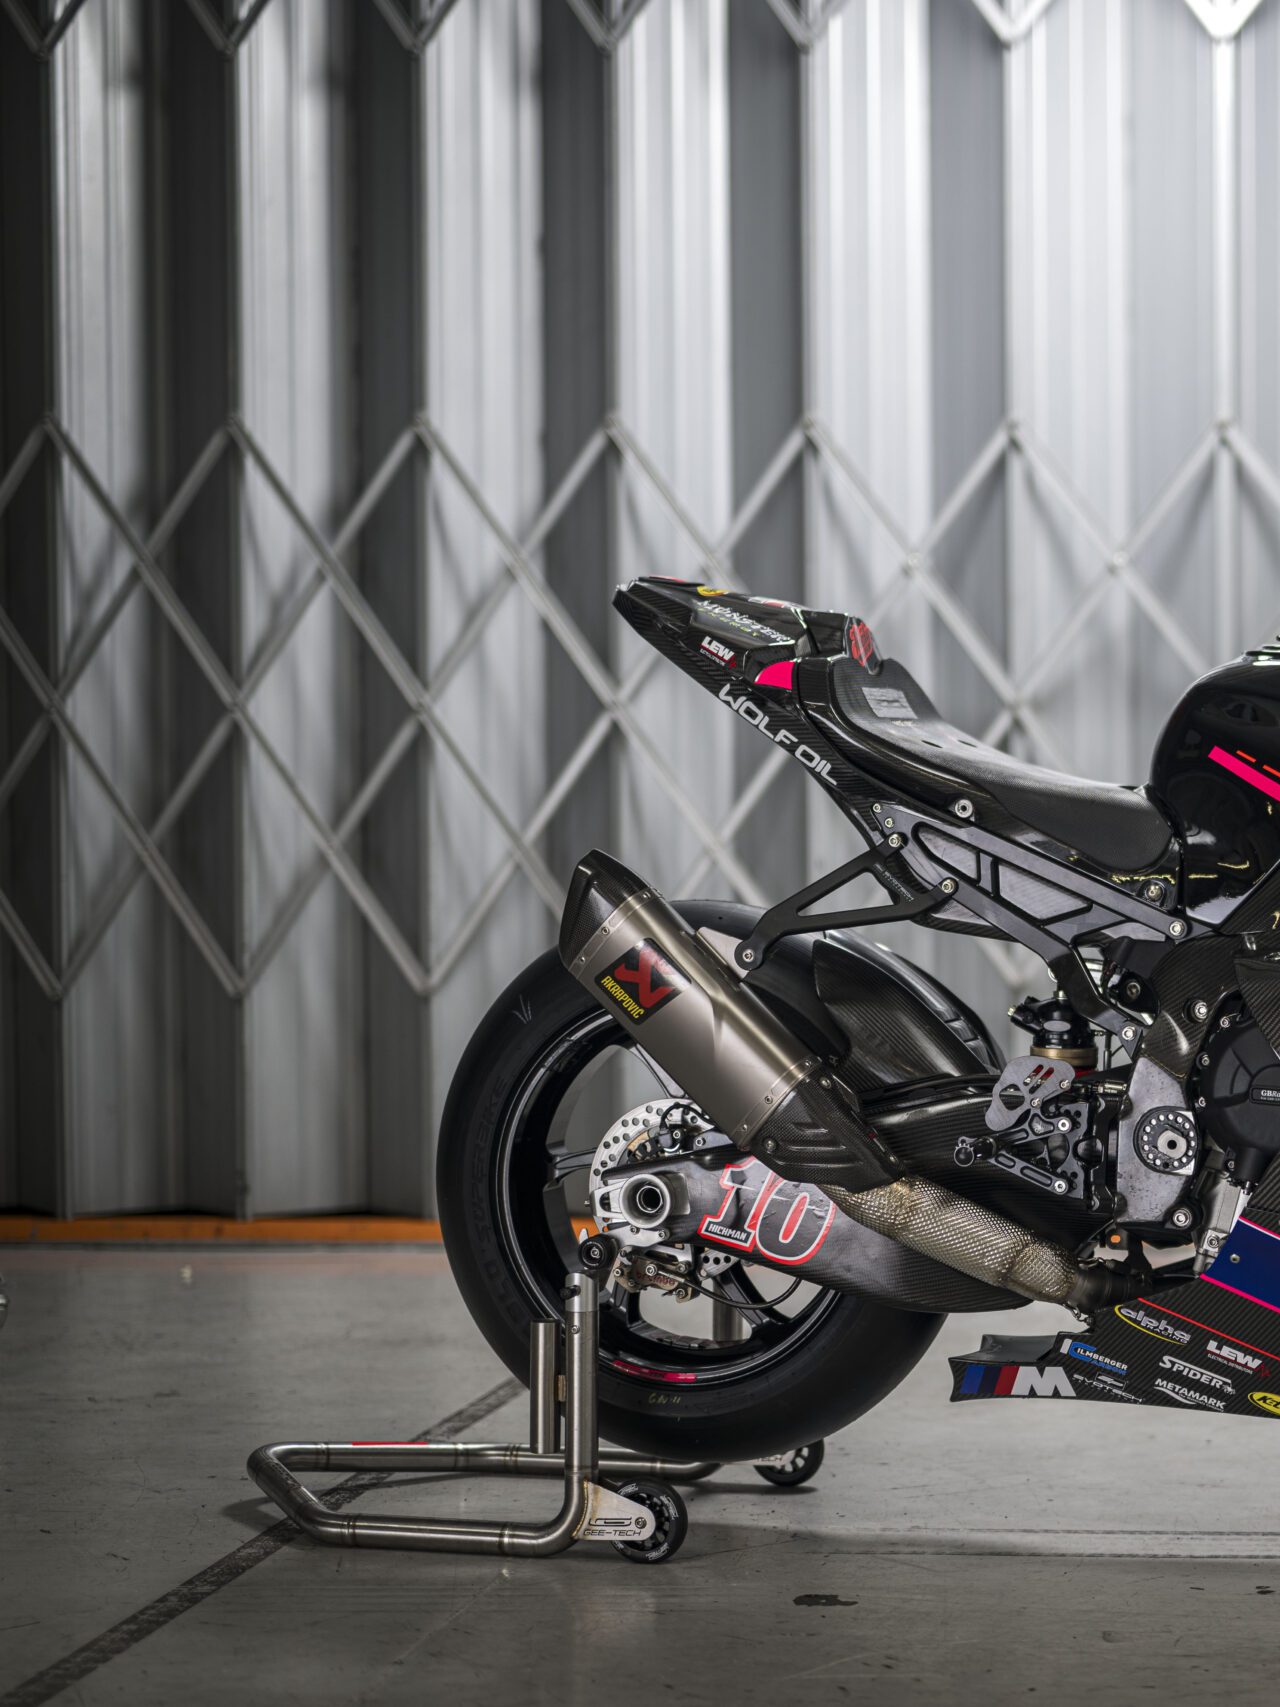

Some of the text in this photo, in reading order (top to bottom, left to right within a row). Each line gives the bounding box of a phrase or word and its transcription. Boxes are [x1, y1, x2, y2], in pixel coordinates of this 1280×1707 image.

[701, 635, 736, 662] LEW
[697, 1154, 836, 1266] 10
[1120, 1306, 1192, 1342] alpha
[1145, 1324, 1188, 1344] RACING
[1076, 1347, 1129, 1371] ILMBERGER
[1206, 1339, 1263, 1369] LEW
[1158, 1355, 1232, 1390] SPIDER
[1154, 1378, 1228, 1410] METAMARK
[583, 1529, 642, 1537] GEE-TECH
